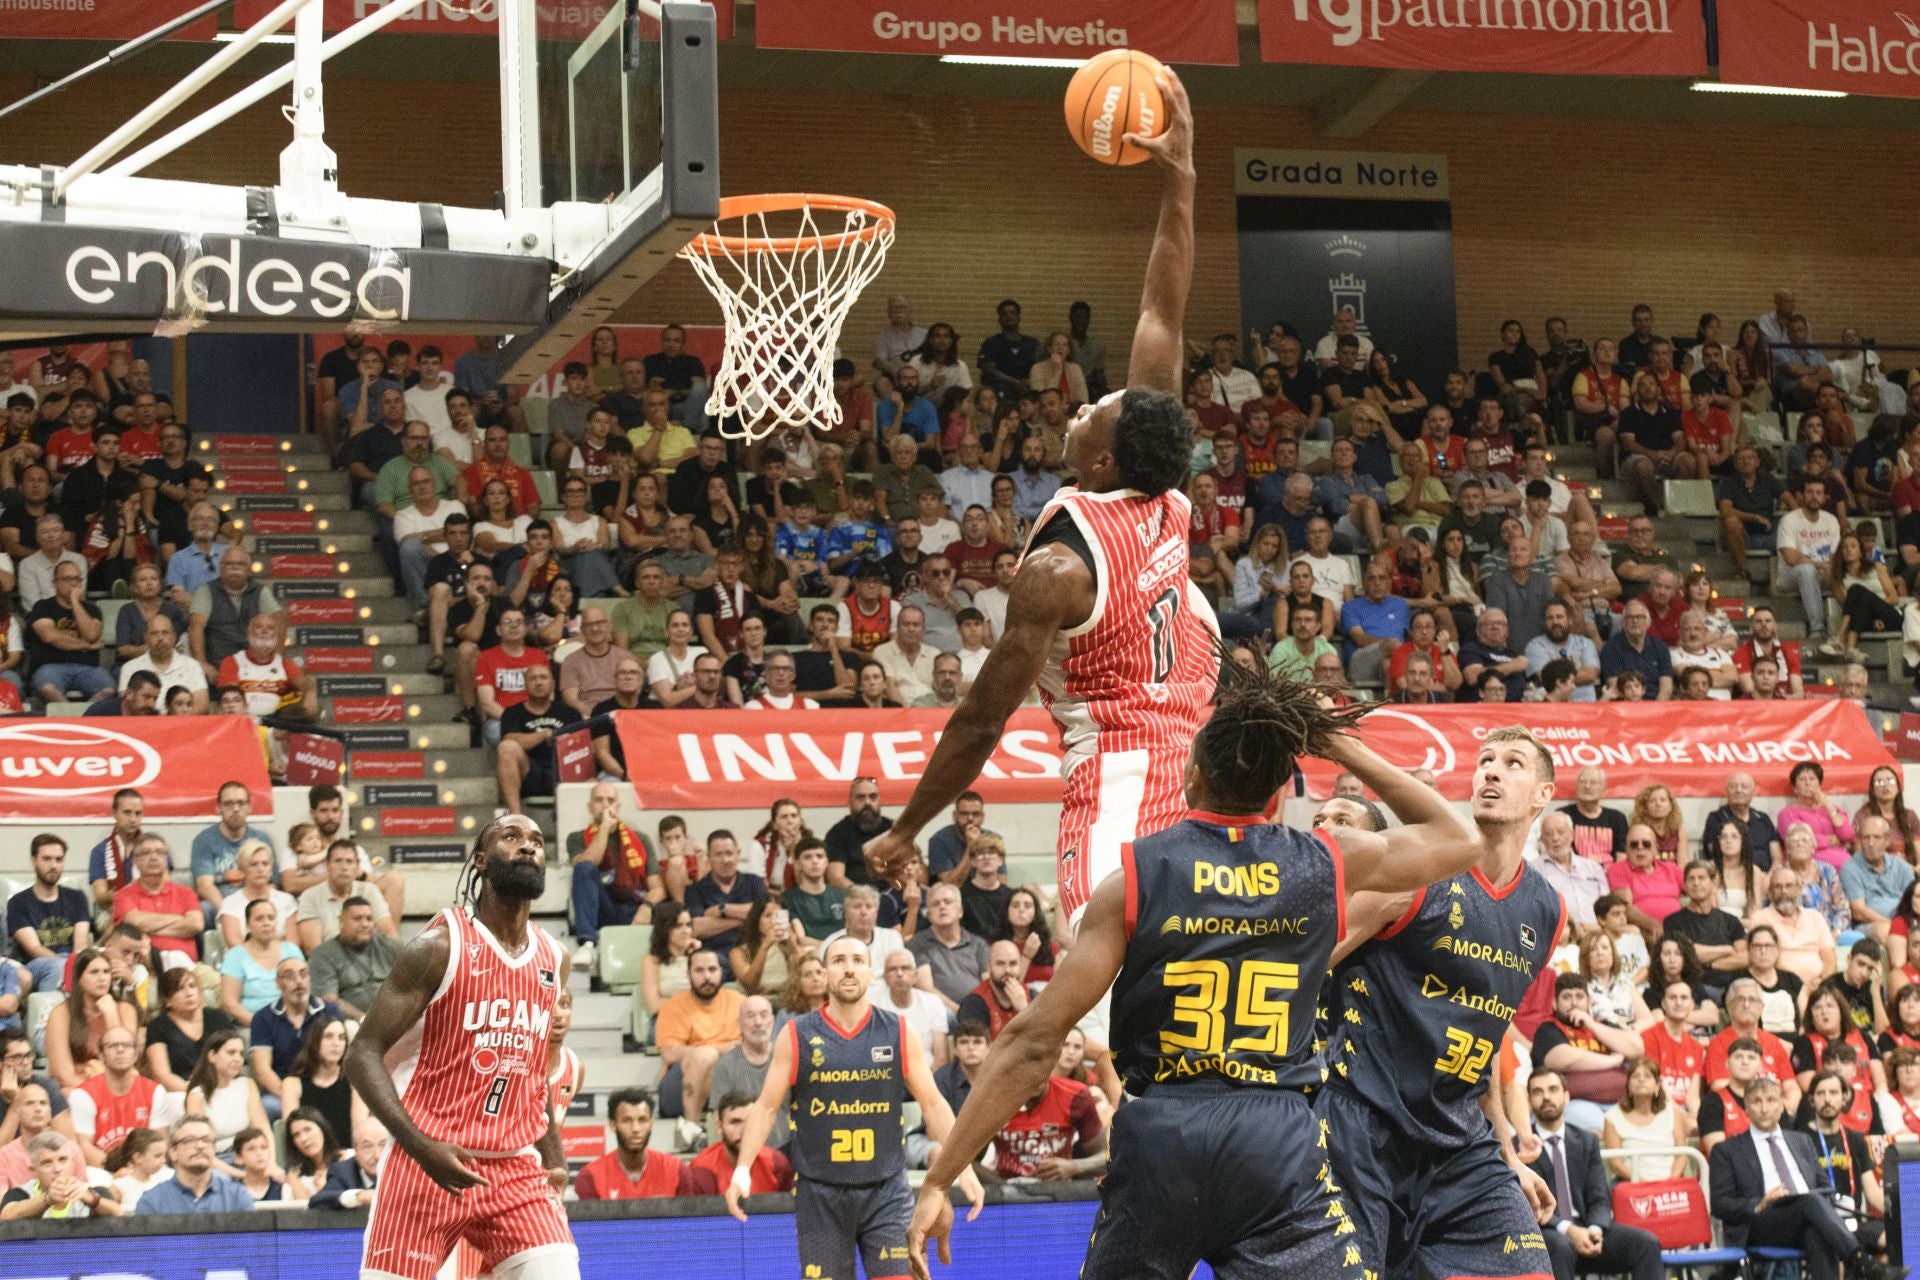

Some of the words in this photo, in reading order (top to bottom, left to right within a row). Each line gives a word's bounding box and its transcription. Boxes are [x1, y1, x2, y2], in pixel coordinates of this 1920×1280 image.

[873, 11, 982, 49] Grupo
[992, 15, 1129, 46] Helvetia
[1368, 0, 1673, 41] patrimonial
[1092, 85, 1123, 156] Wilson
[1246, 159, 1343, 184] Grada
[1357, 162, 1439, 187] Norte
[65, 239, 411, 322] endesa
[2, 756, 134, 777] uver
[1637, 743, 1692, 764] DE
[1697, 739, 1852, 764] MURCIA
[1193, 861, 1280, 897] PONS
[1185, 916, 1309, 936] MORABANC
[1453, 939, 1534, 978] MORABANC
[463, 998, 550, 1040] UCAM
[1159, 959, 1299, 1056] 35
[1176, 1052, 1278, 1084] Andorra
[1435, 1026, 1494, 1084] 32
[820, 1067, 893, 1082] MORABANC
[485, 1075, 508, 1115] 8
[827, 1099, 890, 1115] Andorra
[831, 1128, 875, 1162] 20
